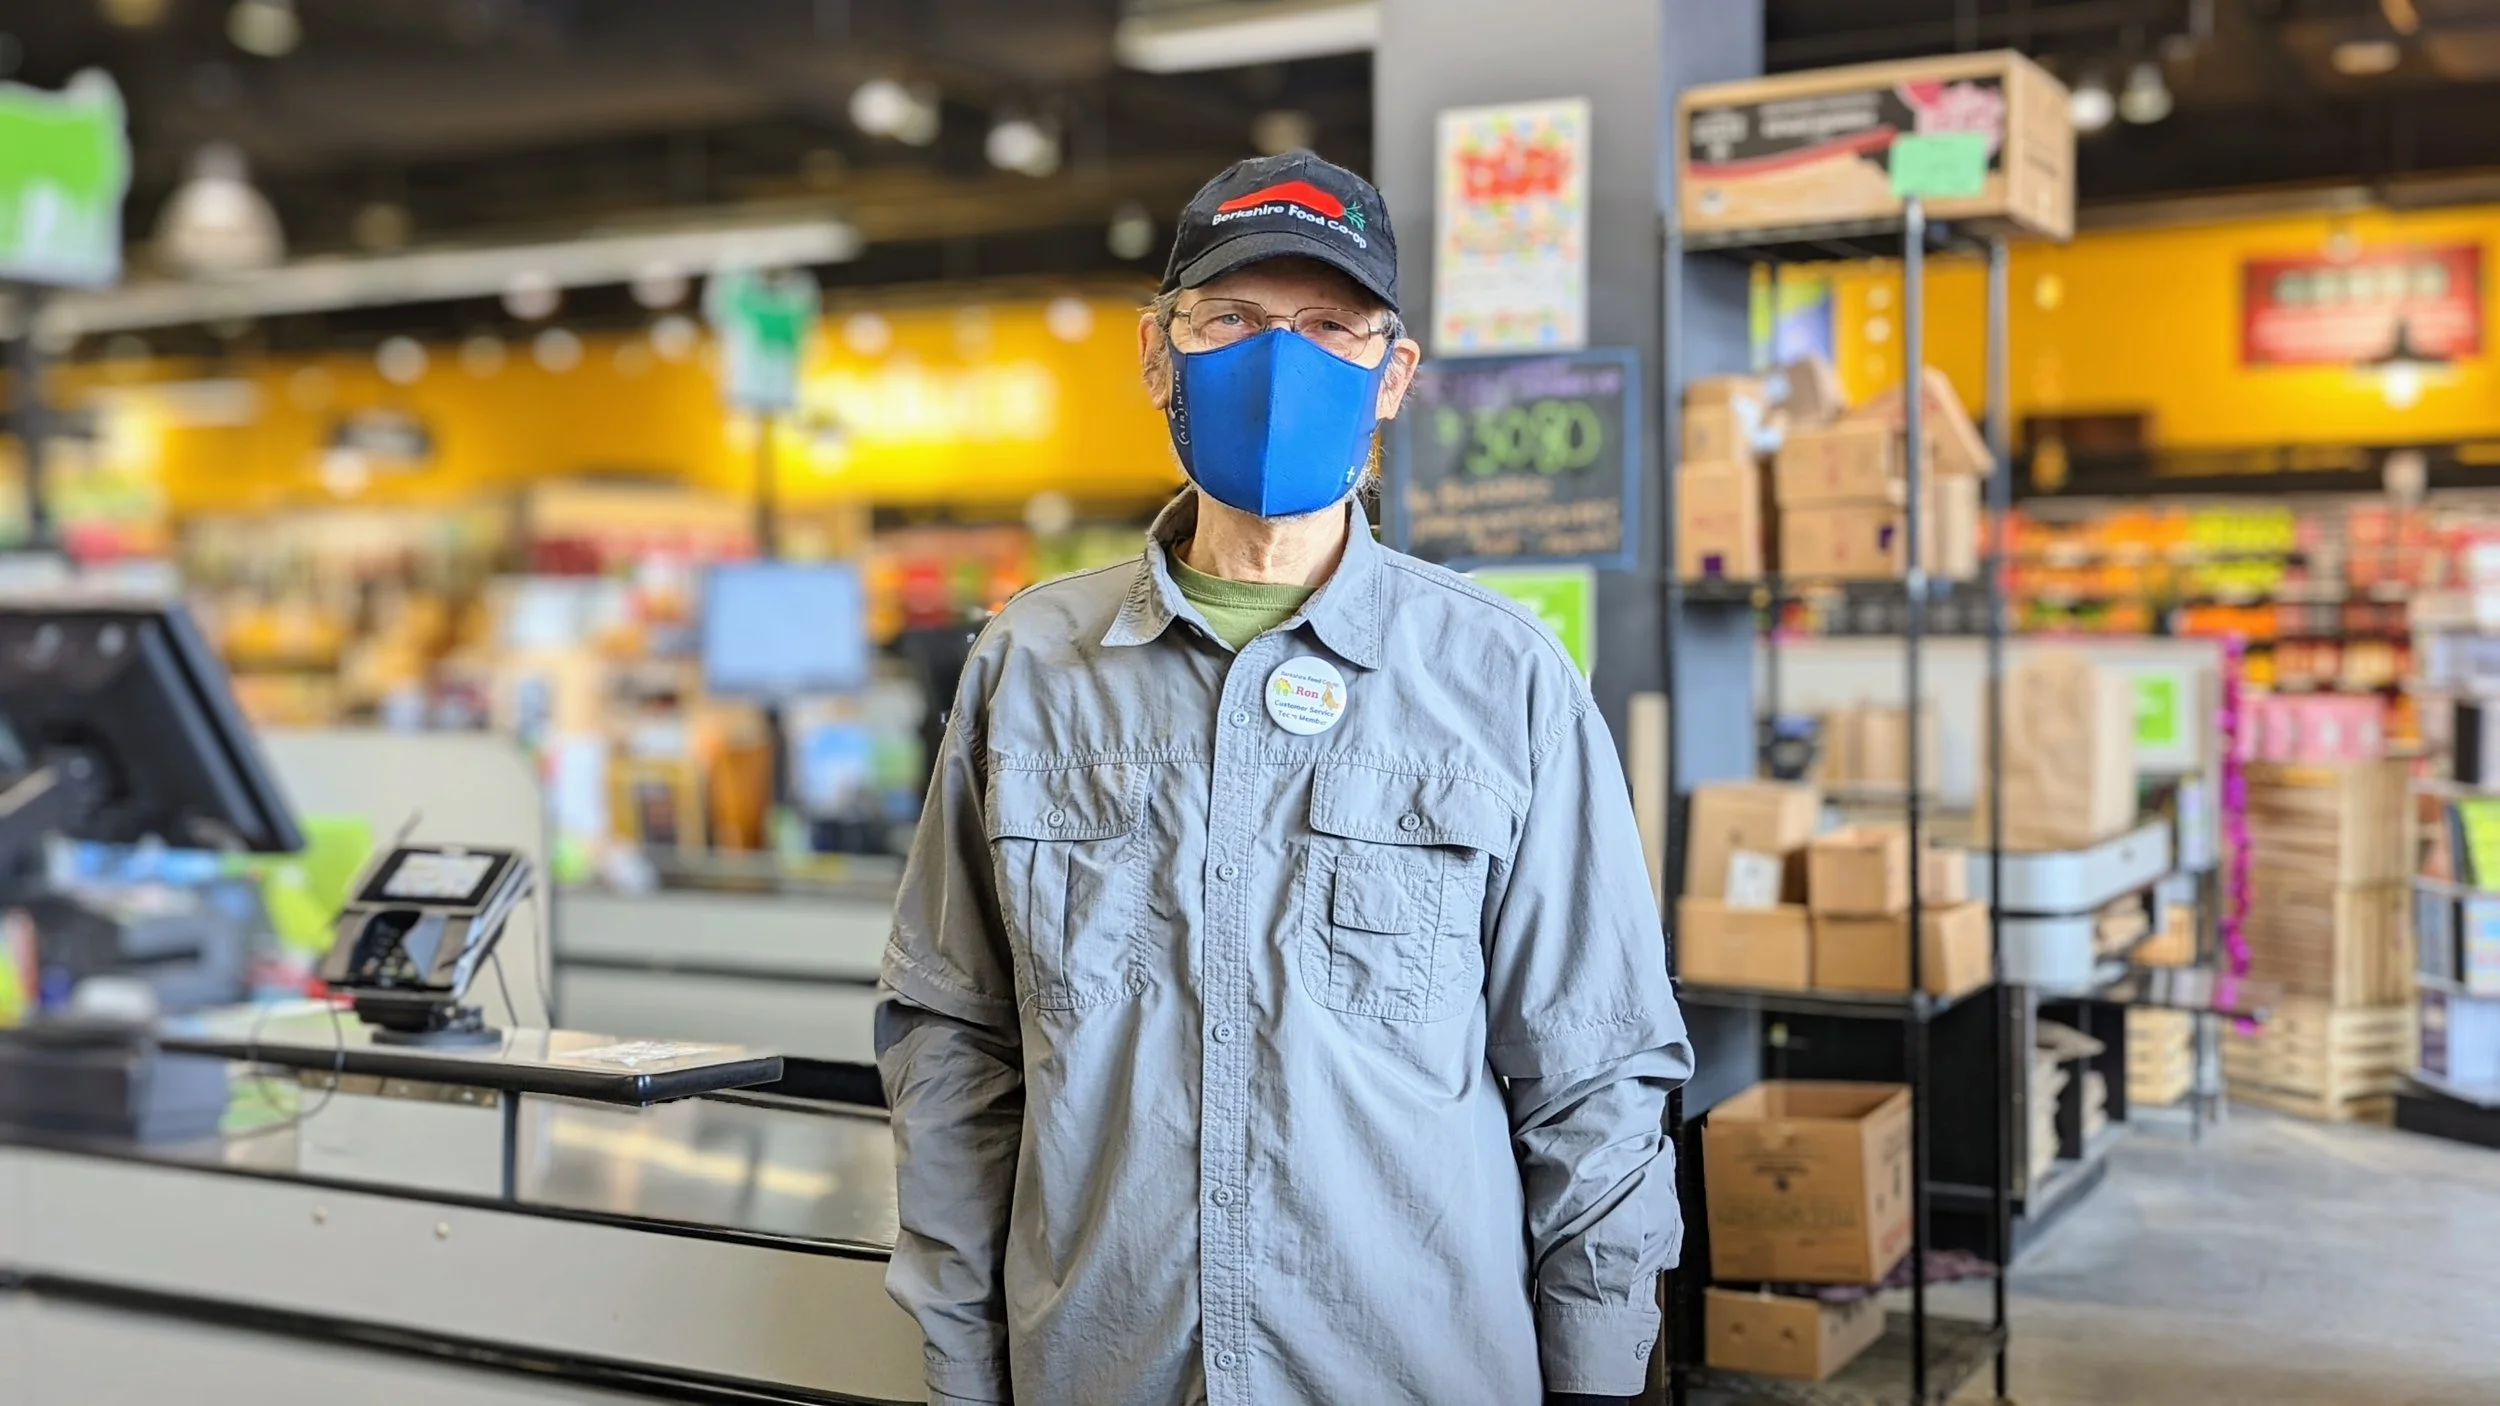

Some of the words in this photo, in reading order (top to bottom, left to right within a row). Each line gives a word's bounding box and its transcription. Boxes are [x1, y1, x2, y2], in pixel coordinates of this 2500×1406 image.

[1211, 204, 1285, 226] Berkshire
[1288, 204, 1326, 226] Food
[1327, 220, 1367, 249] Co-op
[1296, 686, 1319, 699] Ron
[1274, 700, 1308, 711] Customer
[1309, 707, 1335, 717] Service
